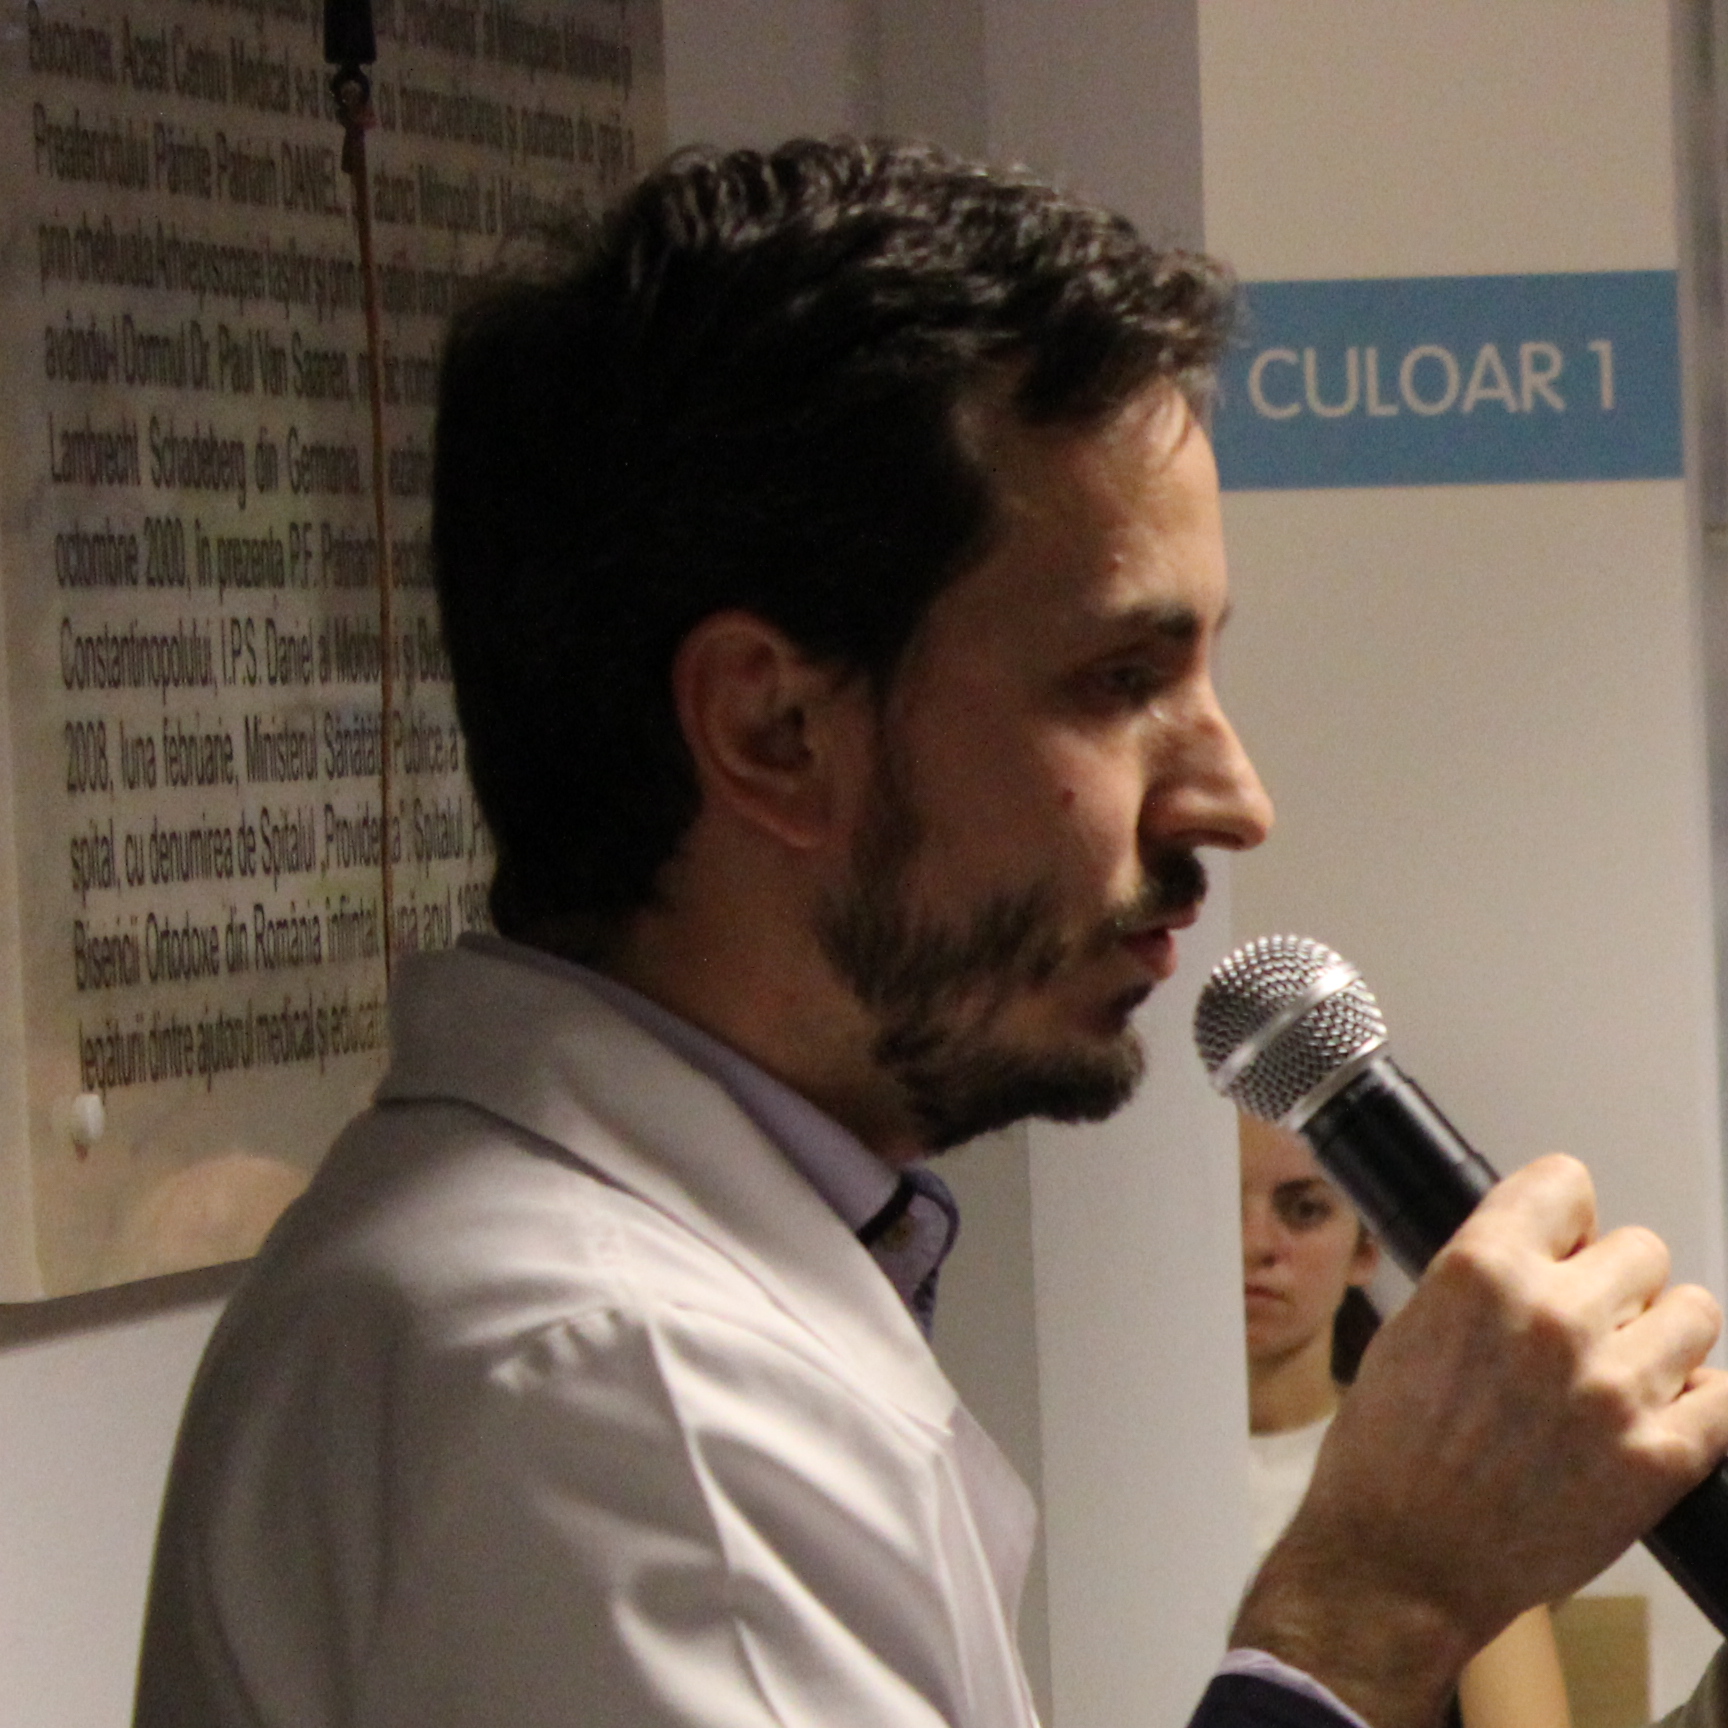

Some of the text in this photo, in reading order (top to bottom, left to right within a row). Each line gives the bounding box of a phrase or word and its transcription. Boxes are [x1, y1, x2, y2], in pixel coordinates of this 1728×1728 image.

[1246, 338, 1614, 421] CULOAR 1
[265, 616, 315, 689] Daniel
[119, 719, 156, 792] luna
[126, 832, 146, 889] cu
[149, 812, 234, 886] denumirea
[237, 808, 257, 880] de
[145, 910, 220, 986] Ortodoxe
[224, 904, 250, 976] din
